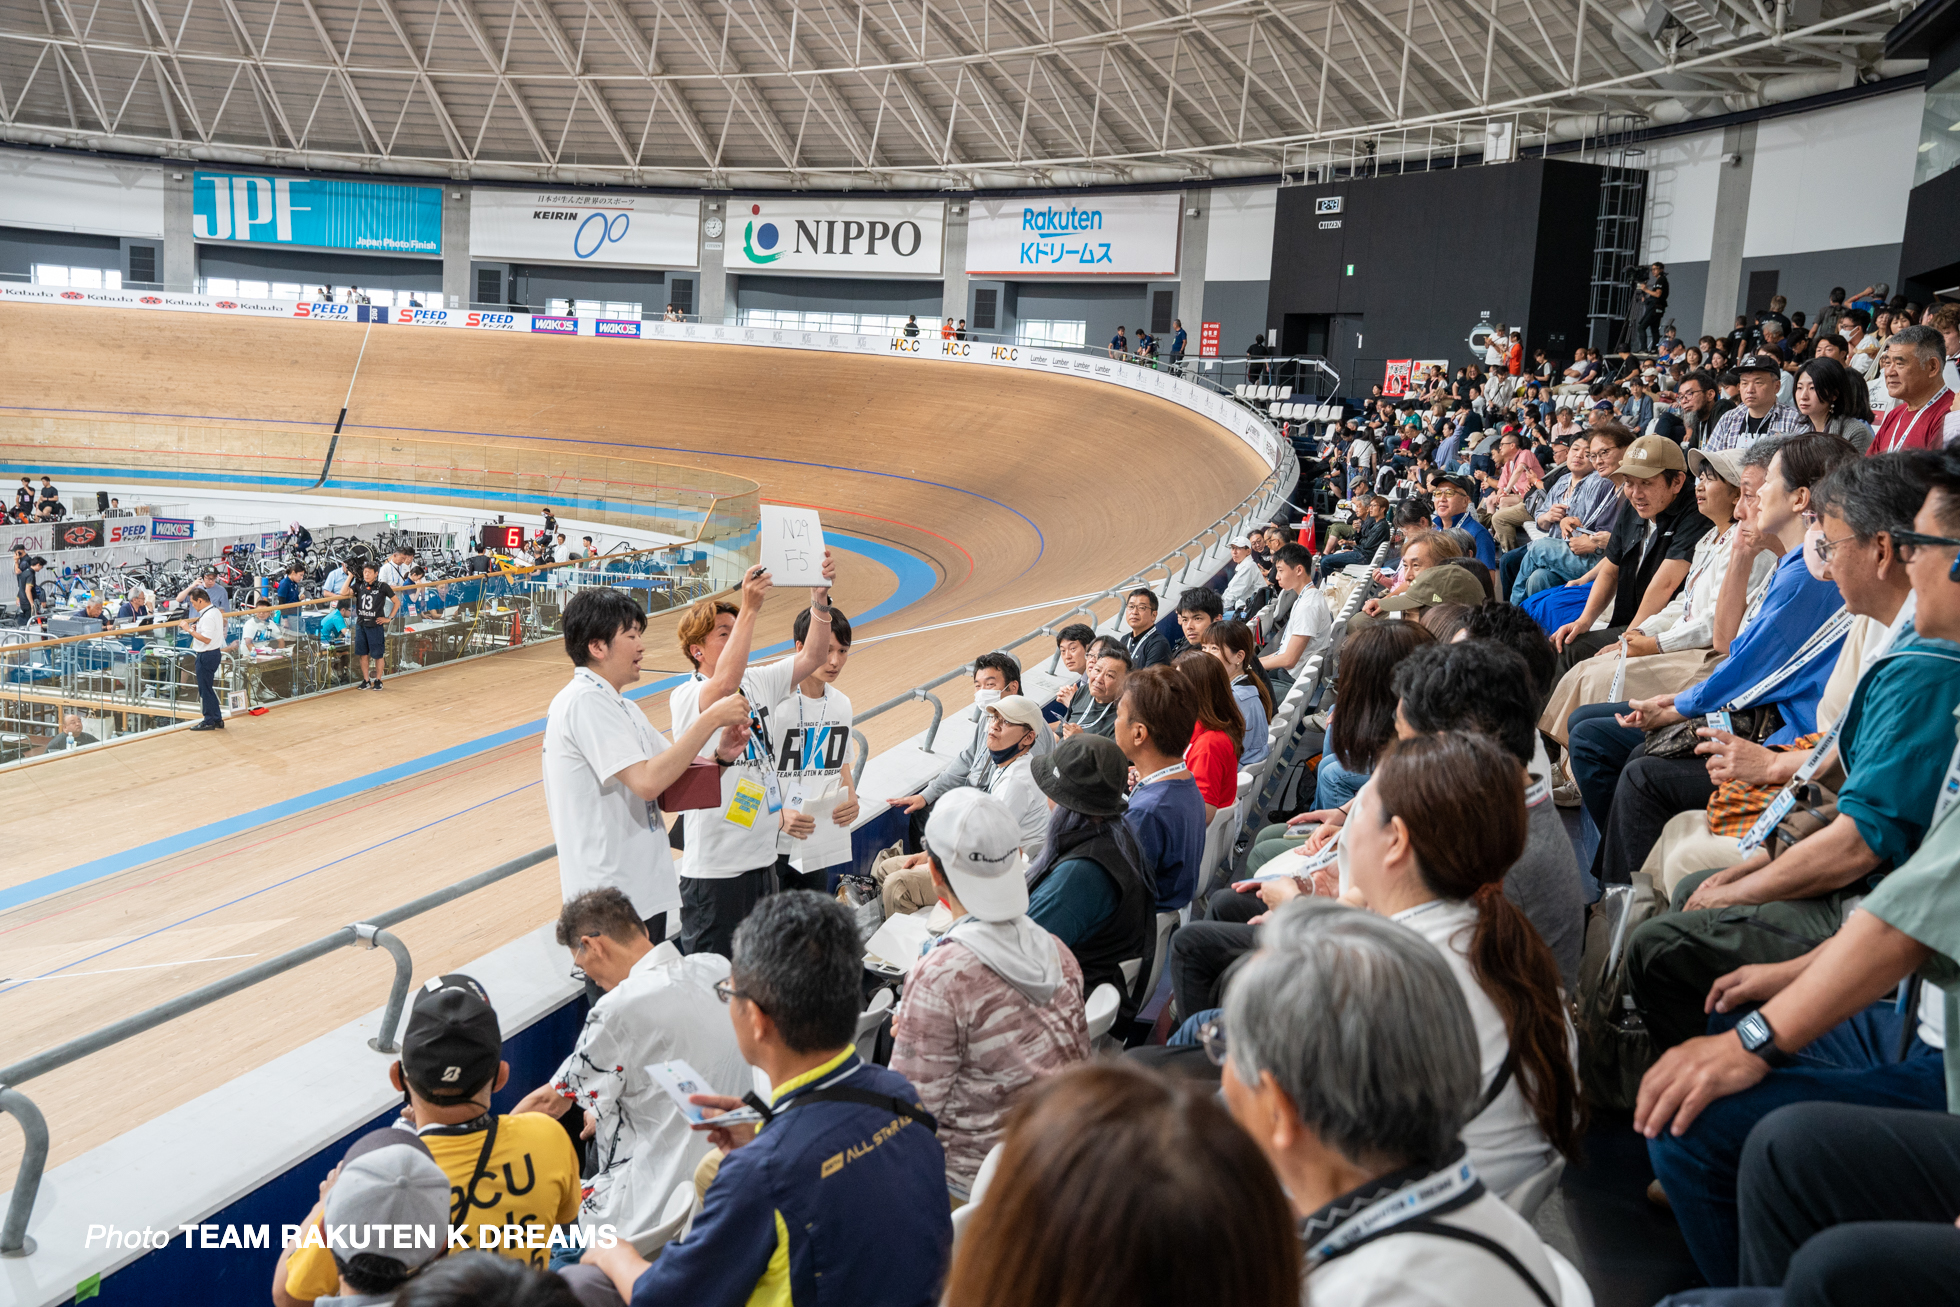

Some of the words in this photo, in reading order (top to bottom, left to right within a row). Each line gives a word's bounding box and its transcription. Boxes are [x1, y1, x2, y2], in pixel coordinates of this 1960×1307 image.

[537, 195, 635, 206] 日本が生んだ世界のスポーツ
[1321, 199, 1339, 211] 12:43
[193, 176, 311, 241] JPF
[533, 211, 578, 221] KEIRIN
[1022, 206, 1103, 231] Rakuten
[1318, 220, 1342, 230] CITIZEN
[356, 236, 382, 248] Japan
[383, 238, 409, 249] Photo
[411, 240, 436, 250] Finish
[793, 219, 922, 257] NIPPO
[1020, 243, 1112, 264] Kドリームス
[6, 288, 54, 297] Kabuto
[87, 294, 133, 302] Kabuto
[165, 299, 210, 307] Kabuto
[240, 303, 283, 312] Kabuto
[293, 302, 349, 317] SPEED
[397, 309, 448, 323] SPEED
[465, 312, 514, 327] SPEED
[1030, 354, 1047, 363] Lumber
[1052, 357, 1069, 366] Lumber
[1074, 360, 1090, 370] Lumber
[1095, 363, 1111, 374] Lumber
[110, 525, 147, 542] SPEED
[507, 528, 519, 547] 6
[783, 517, 810, 546] N29
[785, 549, 809, 571] F5
[361, 594, 373, 610] 13
[1808, 754, 1821, 769] TEAM
[1817, 735, 1834, 756] RAKUTEN
[793, 769, 817, 778] RAUTEN
[969, 847, 1018, 864] Champion
[847, 1141, 875, 1164] ALL
